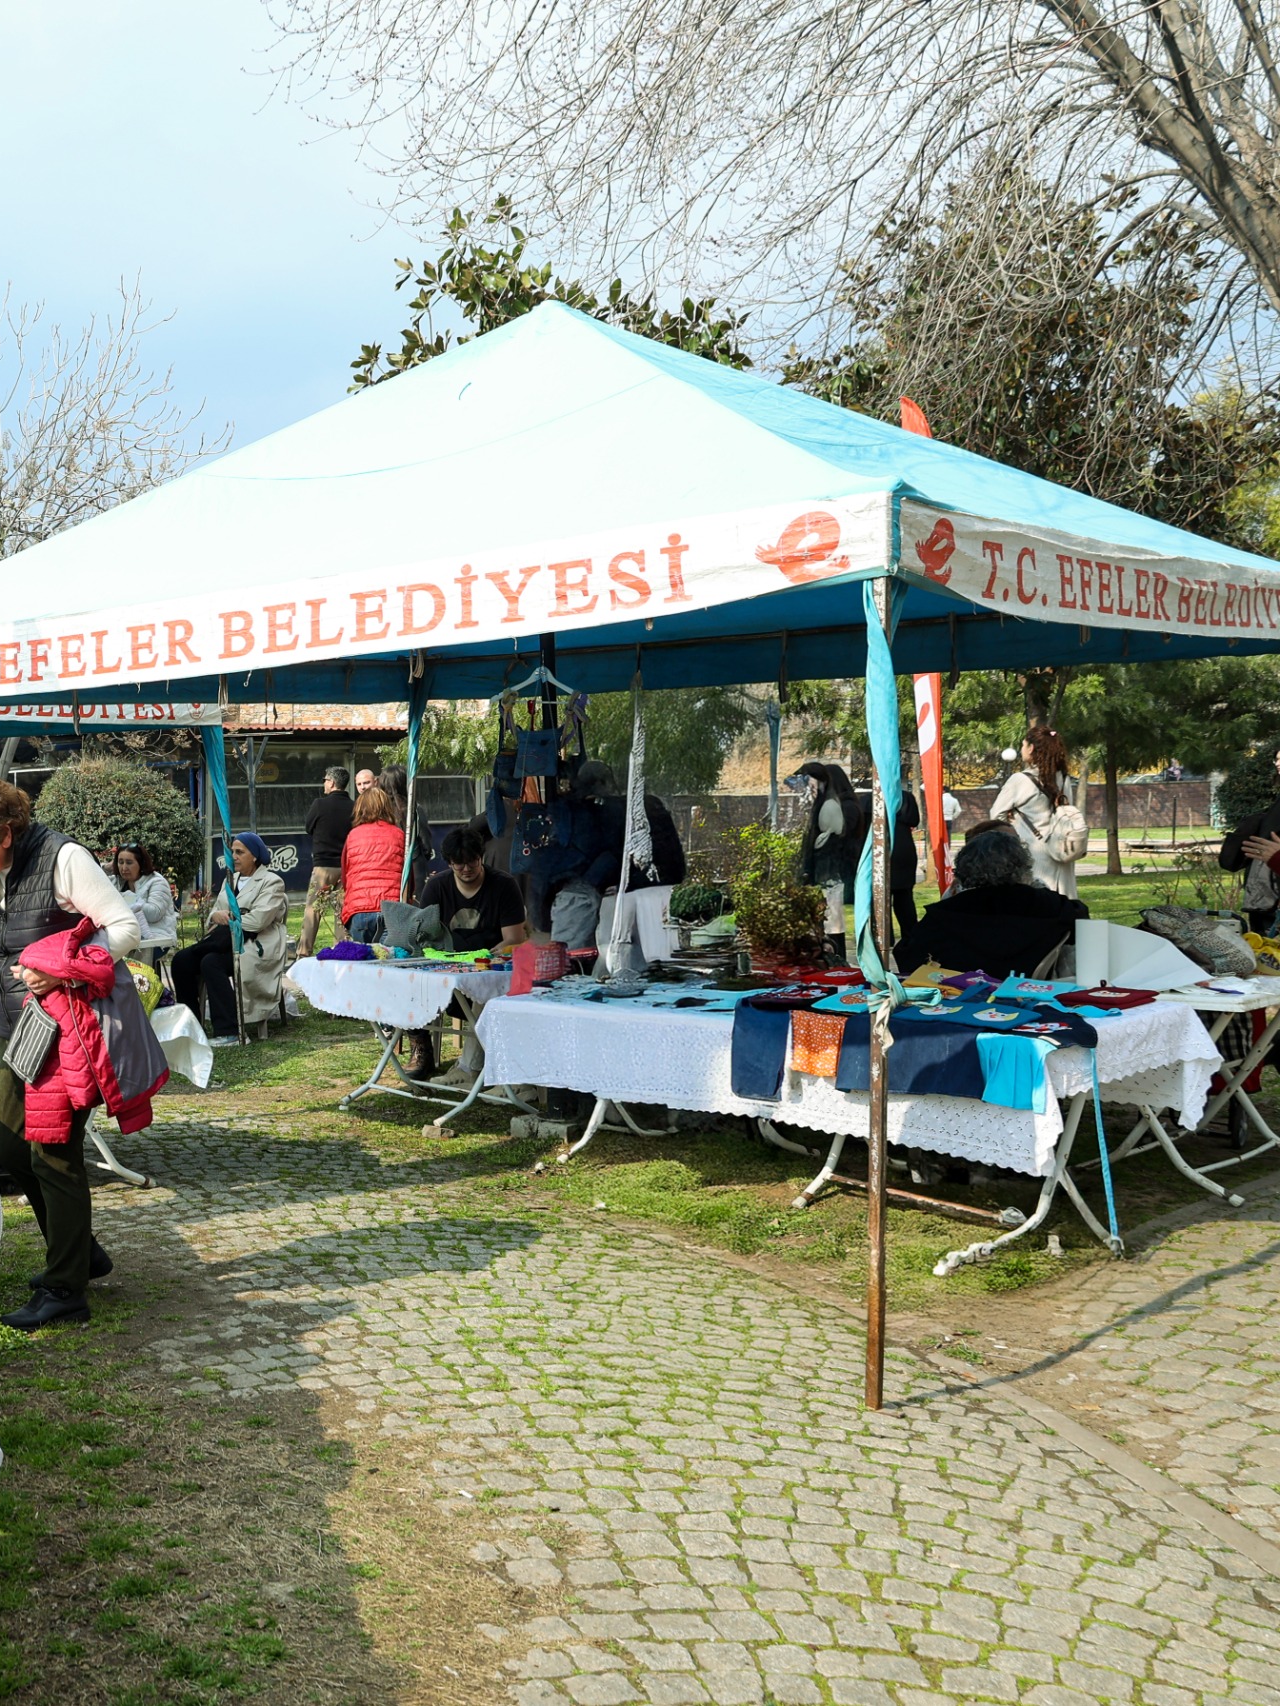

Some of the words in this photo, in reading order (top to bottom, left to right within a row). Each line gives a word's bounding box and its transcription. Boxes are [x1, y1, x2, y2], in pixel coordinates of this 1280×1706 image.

[218, 533, 693, 659] BELEDİYESİ
[982, 541, 1048, 607] T.C.
[1056, 554, 1171, 621] EFELER
